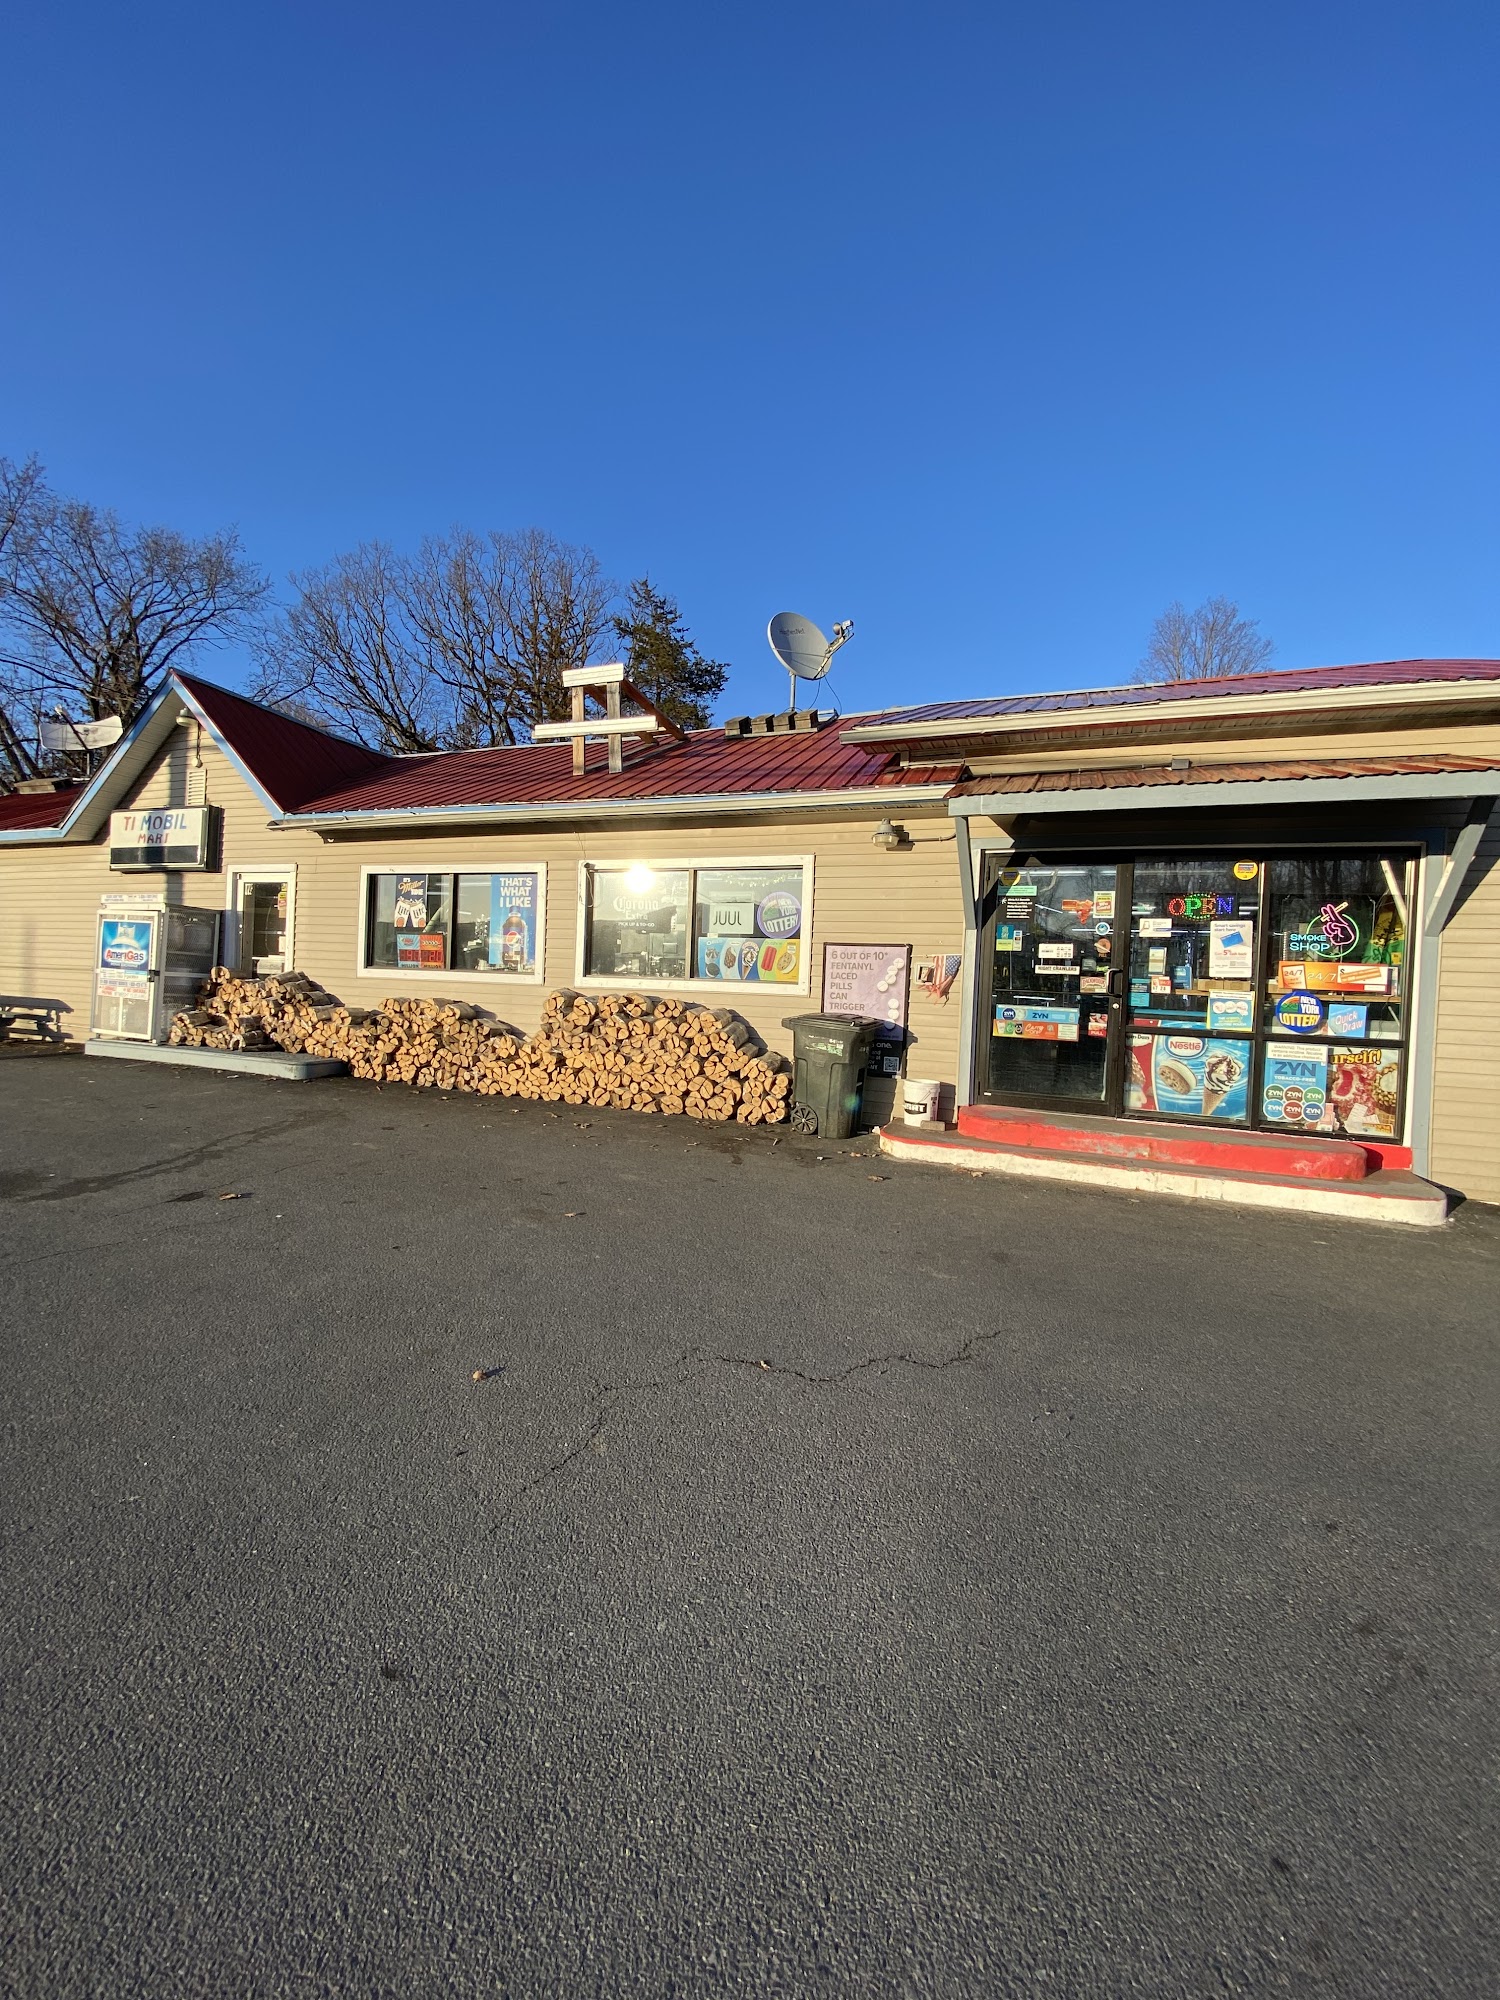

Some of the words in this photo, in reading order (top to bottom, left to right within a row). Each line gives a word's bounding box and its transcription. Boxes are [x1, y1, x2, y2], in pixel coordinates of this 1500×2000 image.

[124, 816, 136, 831] TI
[141, 813, 187, 830] MOBIL
[398, 880, 425, 894] Miller
[500, 877, 533, 887] THAT'S
[500, 887, 532, 897] WHAT
[500, 897, 504, 908] I
[505, 897, 531, 908] LIKE
[613, 896, 659, 913] Corona
[778, 898, 792, 907] NEW
[1168, 896, 1234, 916] OPEN
[397, 905, 410, 916] Lite
[413, 906, 425, 919] Lite
[625, 910, 648, 919] Extra
[780, 905, 797, 916] YORK
[713, 911, 742, 926] JUUL
[763, 914, 799, 933] LOTTERY
[1290, 933, 1327, 941] SMOKE
[1289, 942, 1331, 952] SHOP
[106, 949, 144, 961] AmeriGas
[831, 950, 838, 960] 6
[840, 952, 858, 960] OUT
[860, 952, 872, 960] OF
[831, 961, 874, 971] FENTANYL
[830, 972, 858, 980] LACED
[1307, 973, 1337, 982] 24/7
[830, 982, 853, 990] PILLS
[829, 992, 848, 1000] CAN
[1300, 996, 1317, 1005] NEW
[829, 1002, 865, 1011] TRIGGER
[1300, 1004, 1320, 1014] YORK
[1279, 1013, 1321, 1027] LOTTERY
[1335, 1010, 1357, 1024] Quick
[1342, 1020, 1363, 1033] Draw
[1274, 1061, 1317, 1077] ZYN
